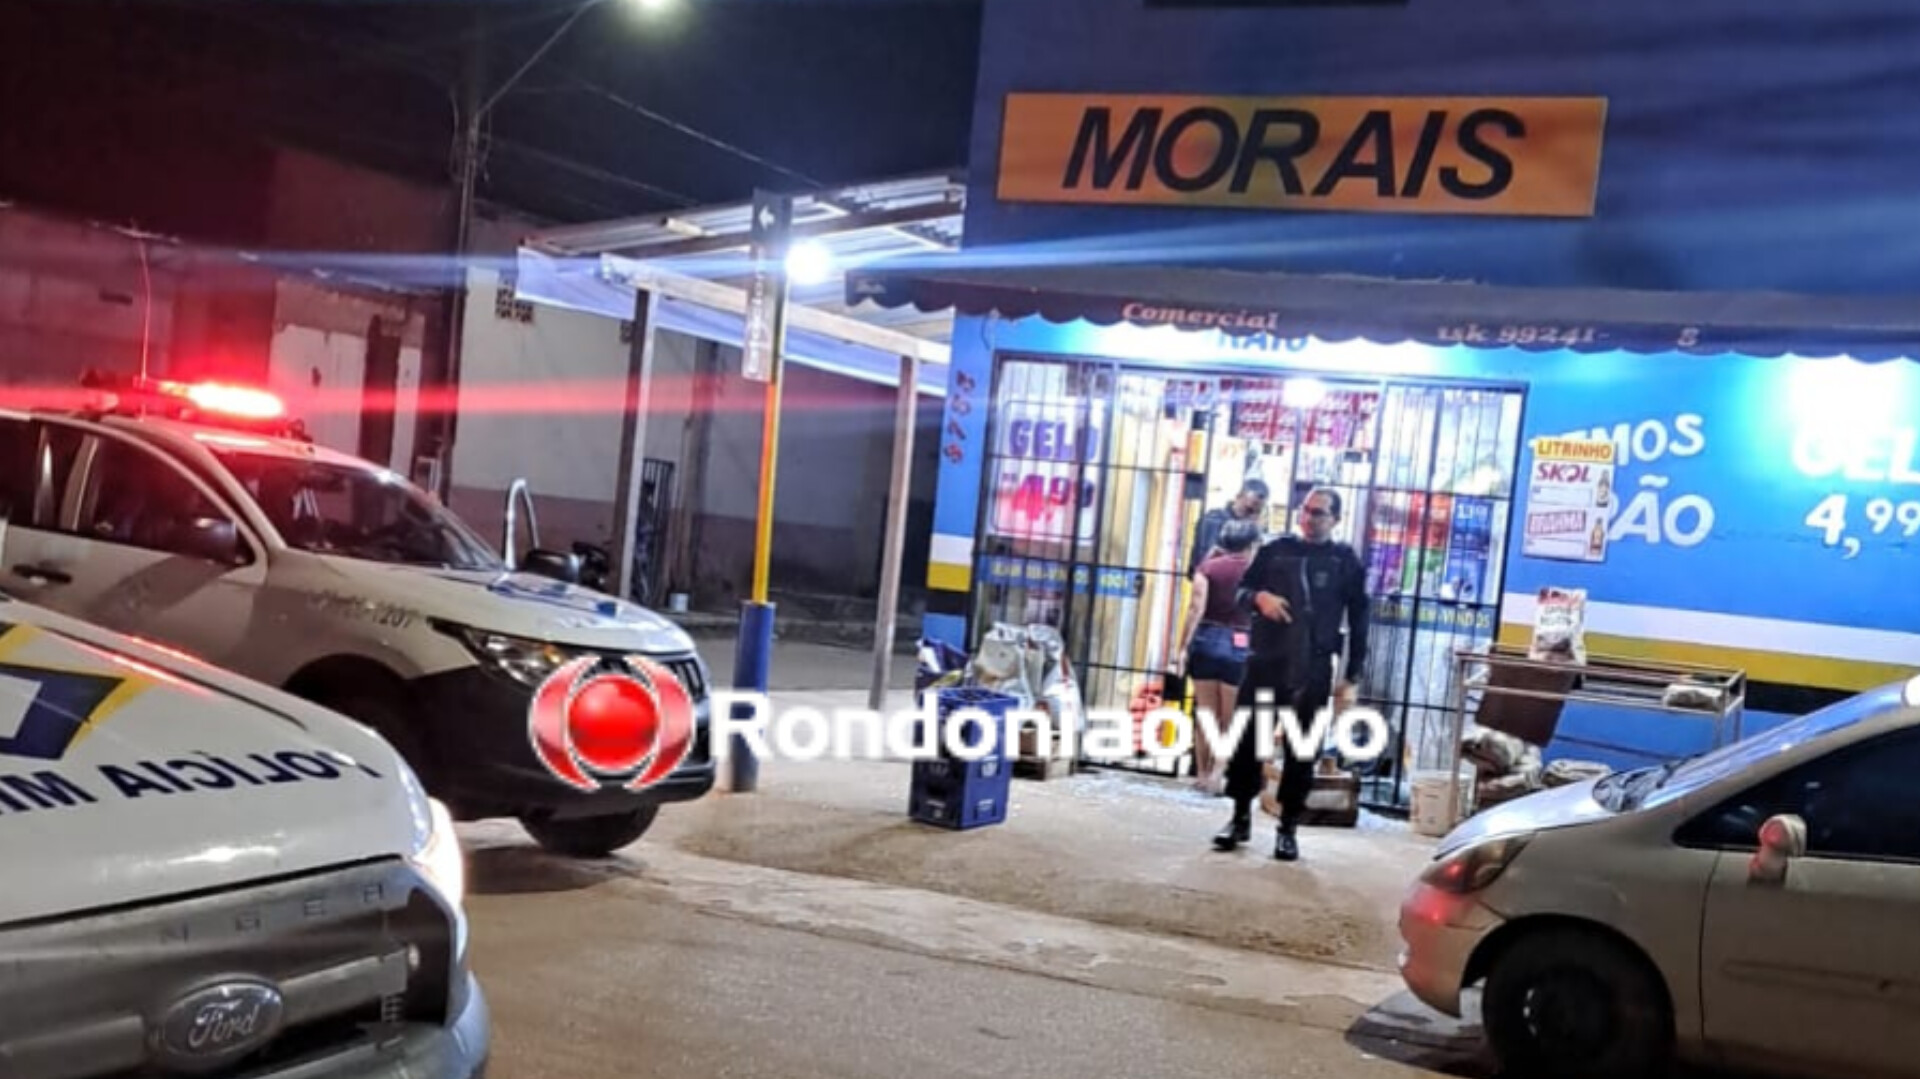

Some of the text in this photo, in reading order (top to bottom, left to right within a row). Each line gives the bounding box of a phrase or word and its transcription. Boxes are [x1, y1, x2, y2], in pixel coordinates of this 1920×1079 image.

[1062, 107, 1526, 199] MORAIS
[1122, 303, 1279, 329] Comercial
[1528, 412, 1706, 467] MOS
[1537, 439, 1613, 460] LITRINHO
[1537, 463, 1591, 483] SKOL
[1608, 474, 1716, 547] ÃO
[1805, 493, 1920, 560] 4,99
[188, 999, 260, 1047] Ford
